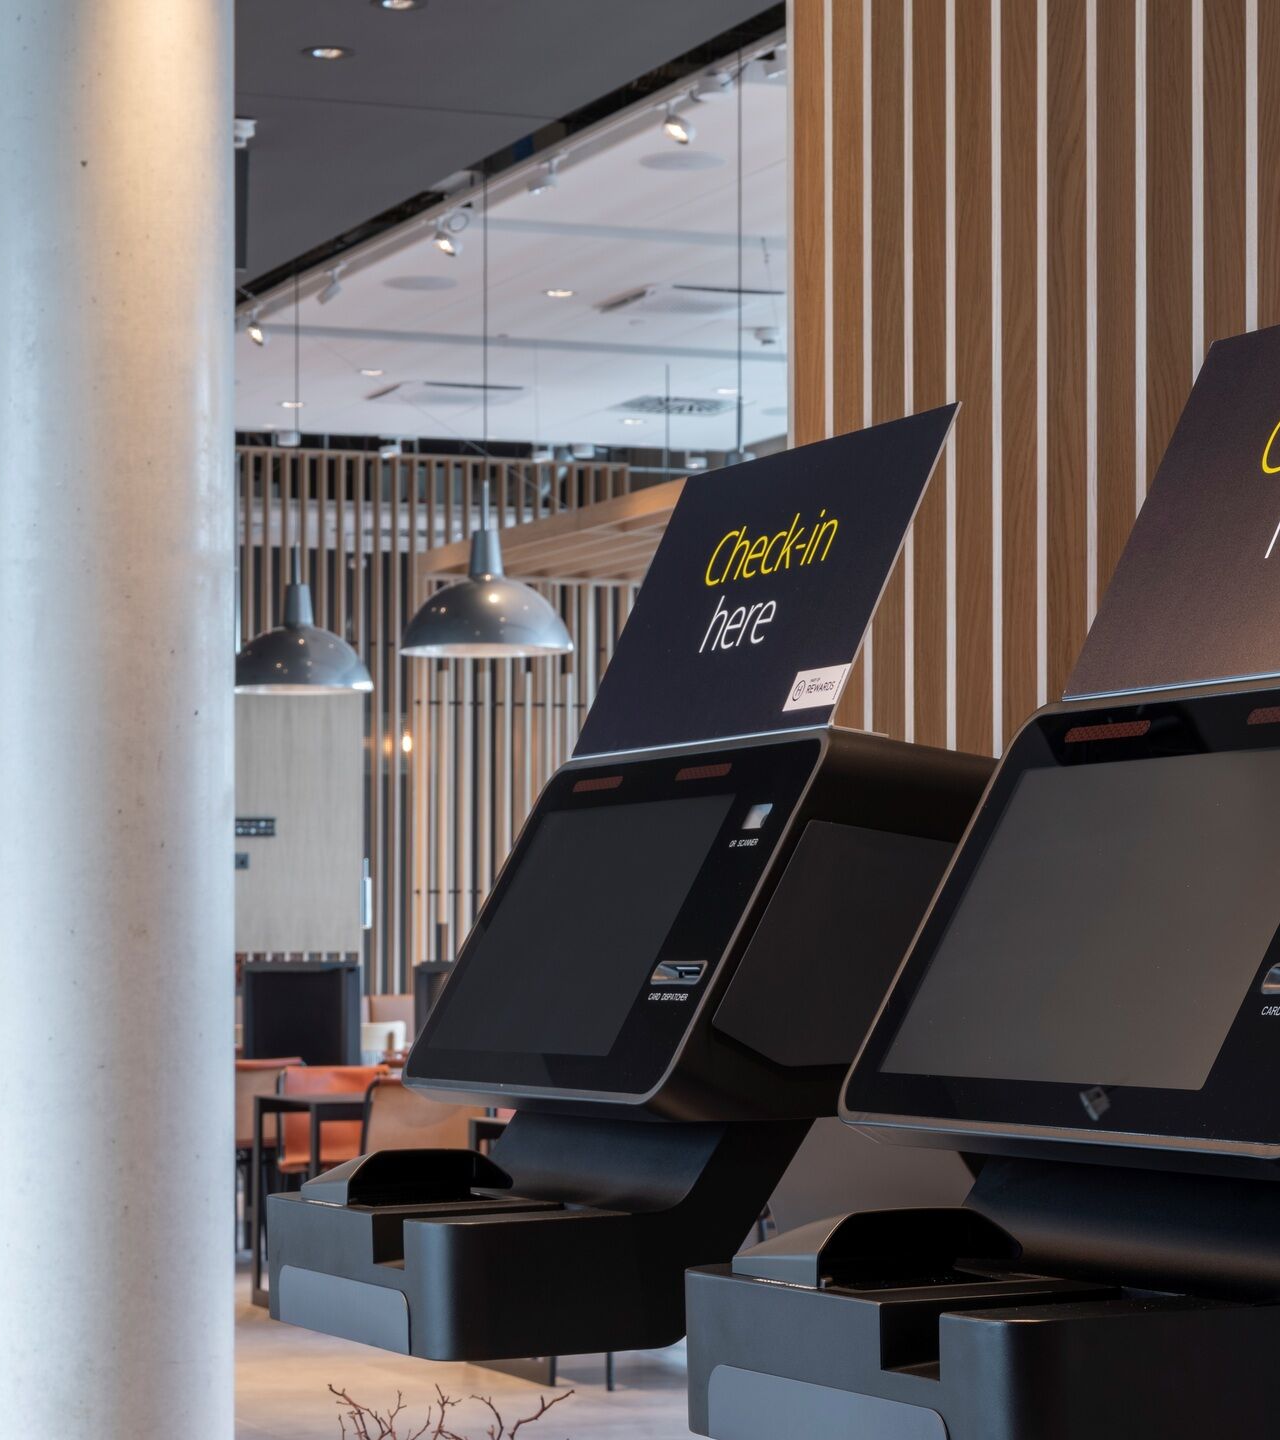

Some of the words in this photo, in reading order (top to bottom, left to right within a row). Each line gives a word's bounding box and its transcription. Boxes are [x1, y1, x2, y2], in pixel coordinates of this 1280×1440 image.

[705, 509, 839, 587] Check-in
[699, 595, 777, 654] here
[806, 681, 836, 694] REWARDS
